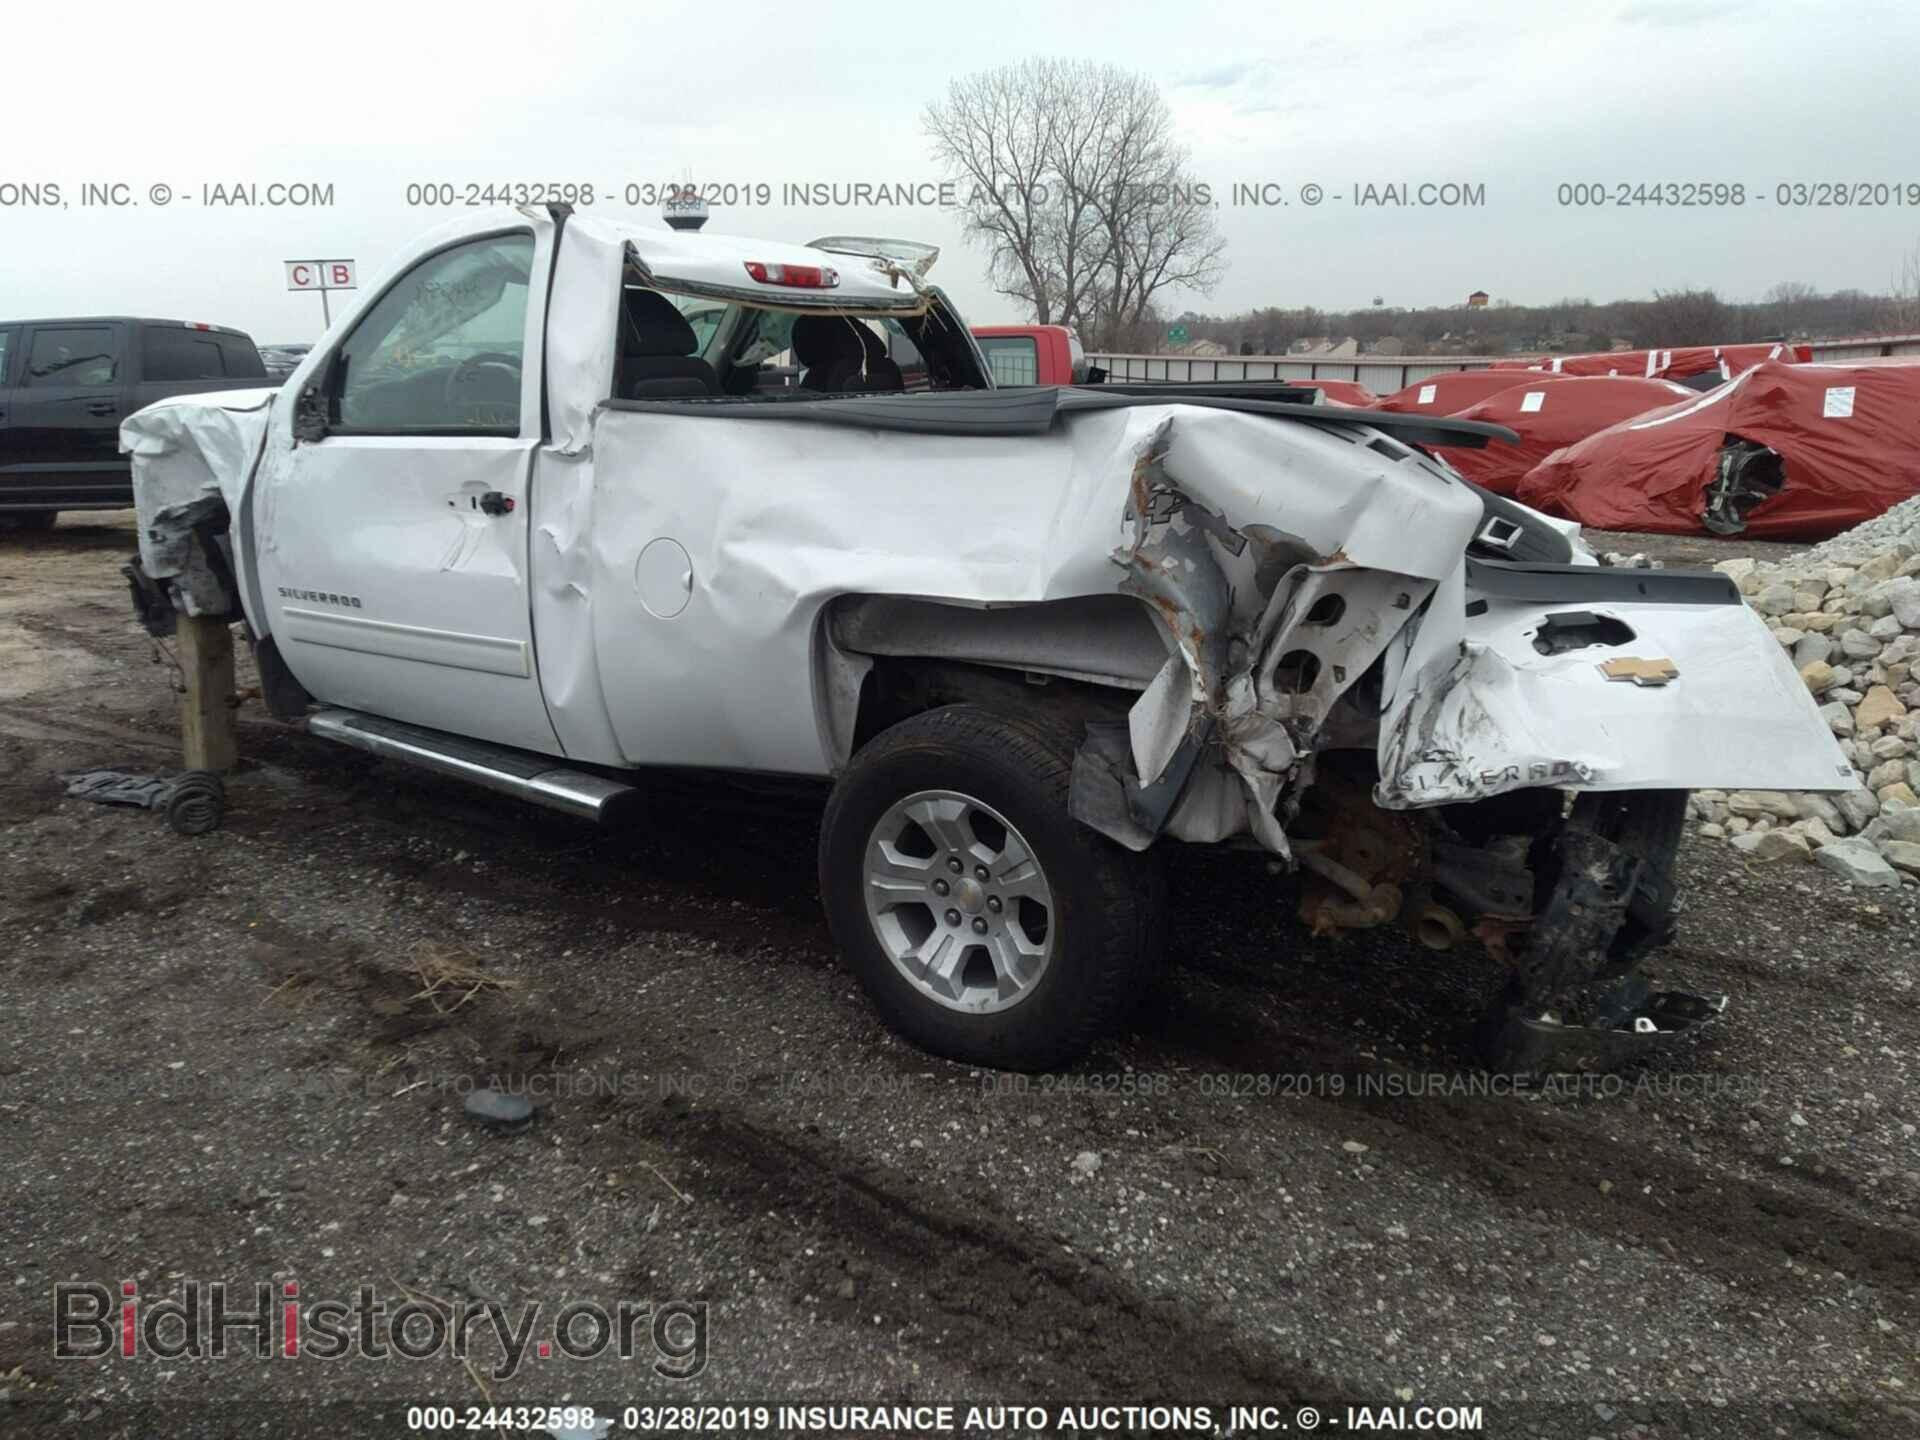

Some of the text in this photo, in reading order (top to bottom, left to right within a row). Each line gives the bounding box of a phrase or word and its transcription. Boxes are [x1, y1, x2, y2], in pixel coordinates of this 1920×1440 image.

[293, 265, 350, 286] C B
[278, 586, 362, 608] SILVERADO
